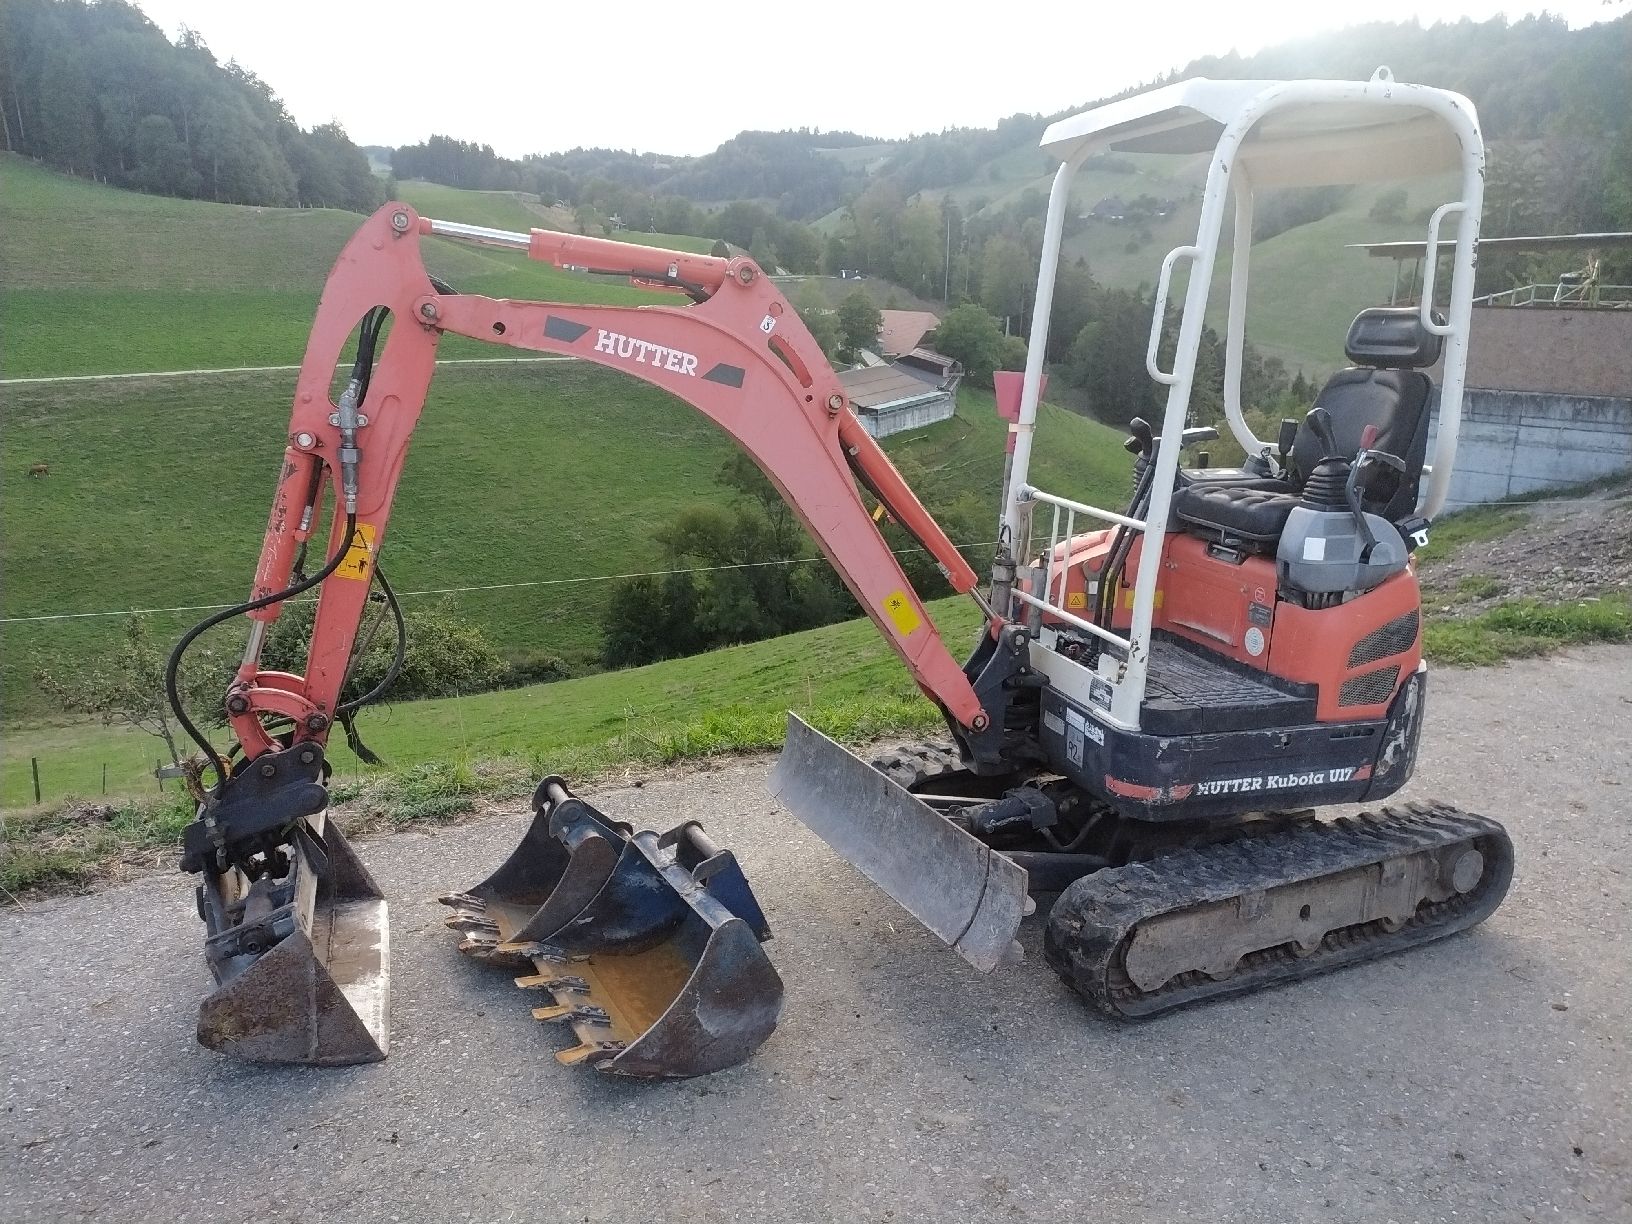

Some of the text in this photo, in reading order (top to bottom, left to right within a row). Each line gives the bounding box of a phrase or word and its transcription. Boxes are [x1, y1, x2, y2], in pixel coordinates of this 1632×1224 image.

[594, 329, 698, 376] HUTTER
[1196, 767, 1353, 795] HUTTER Kubota U17
